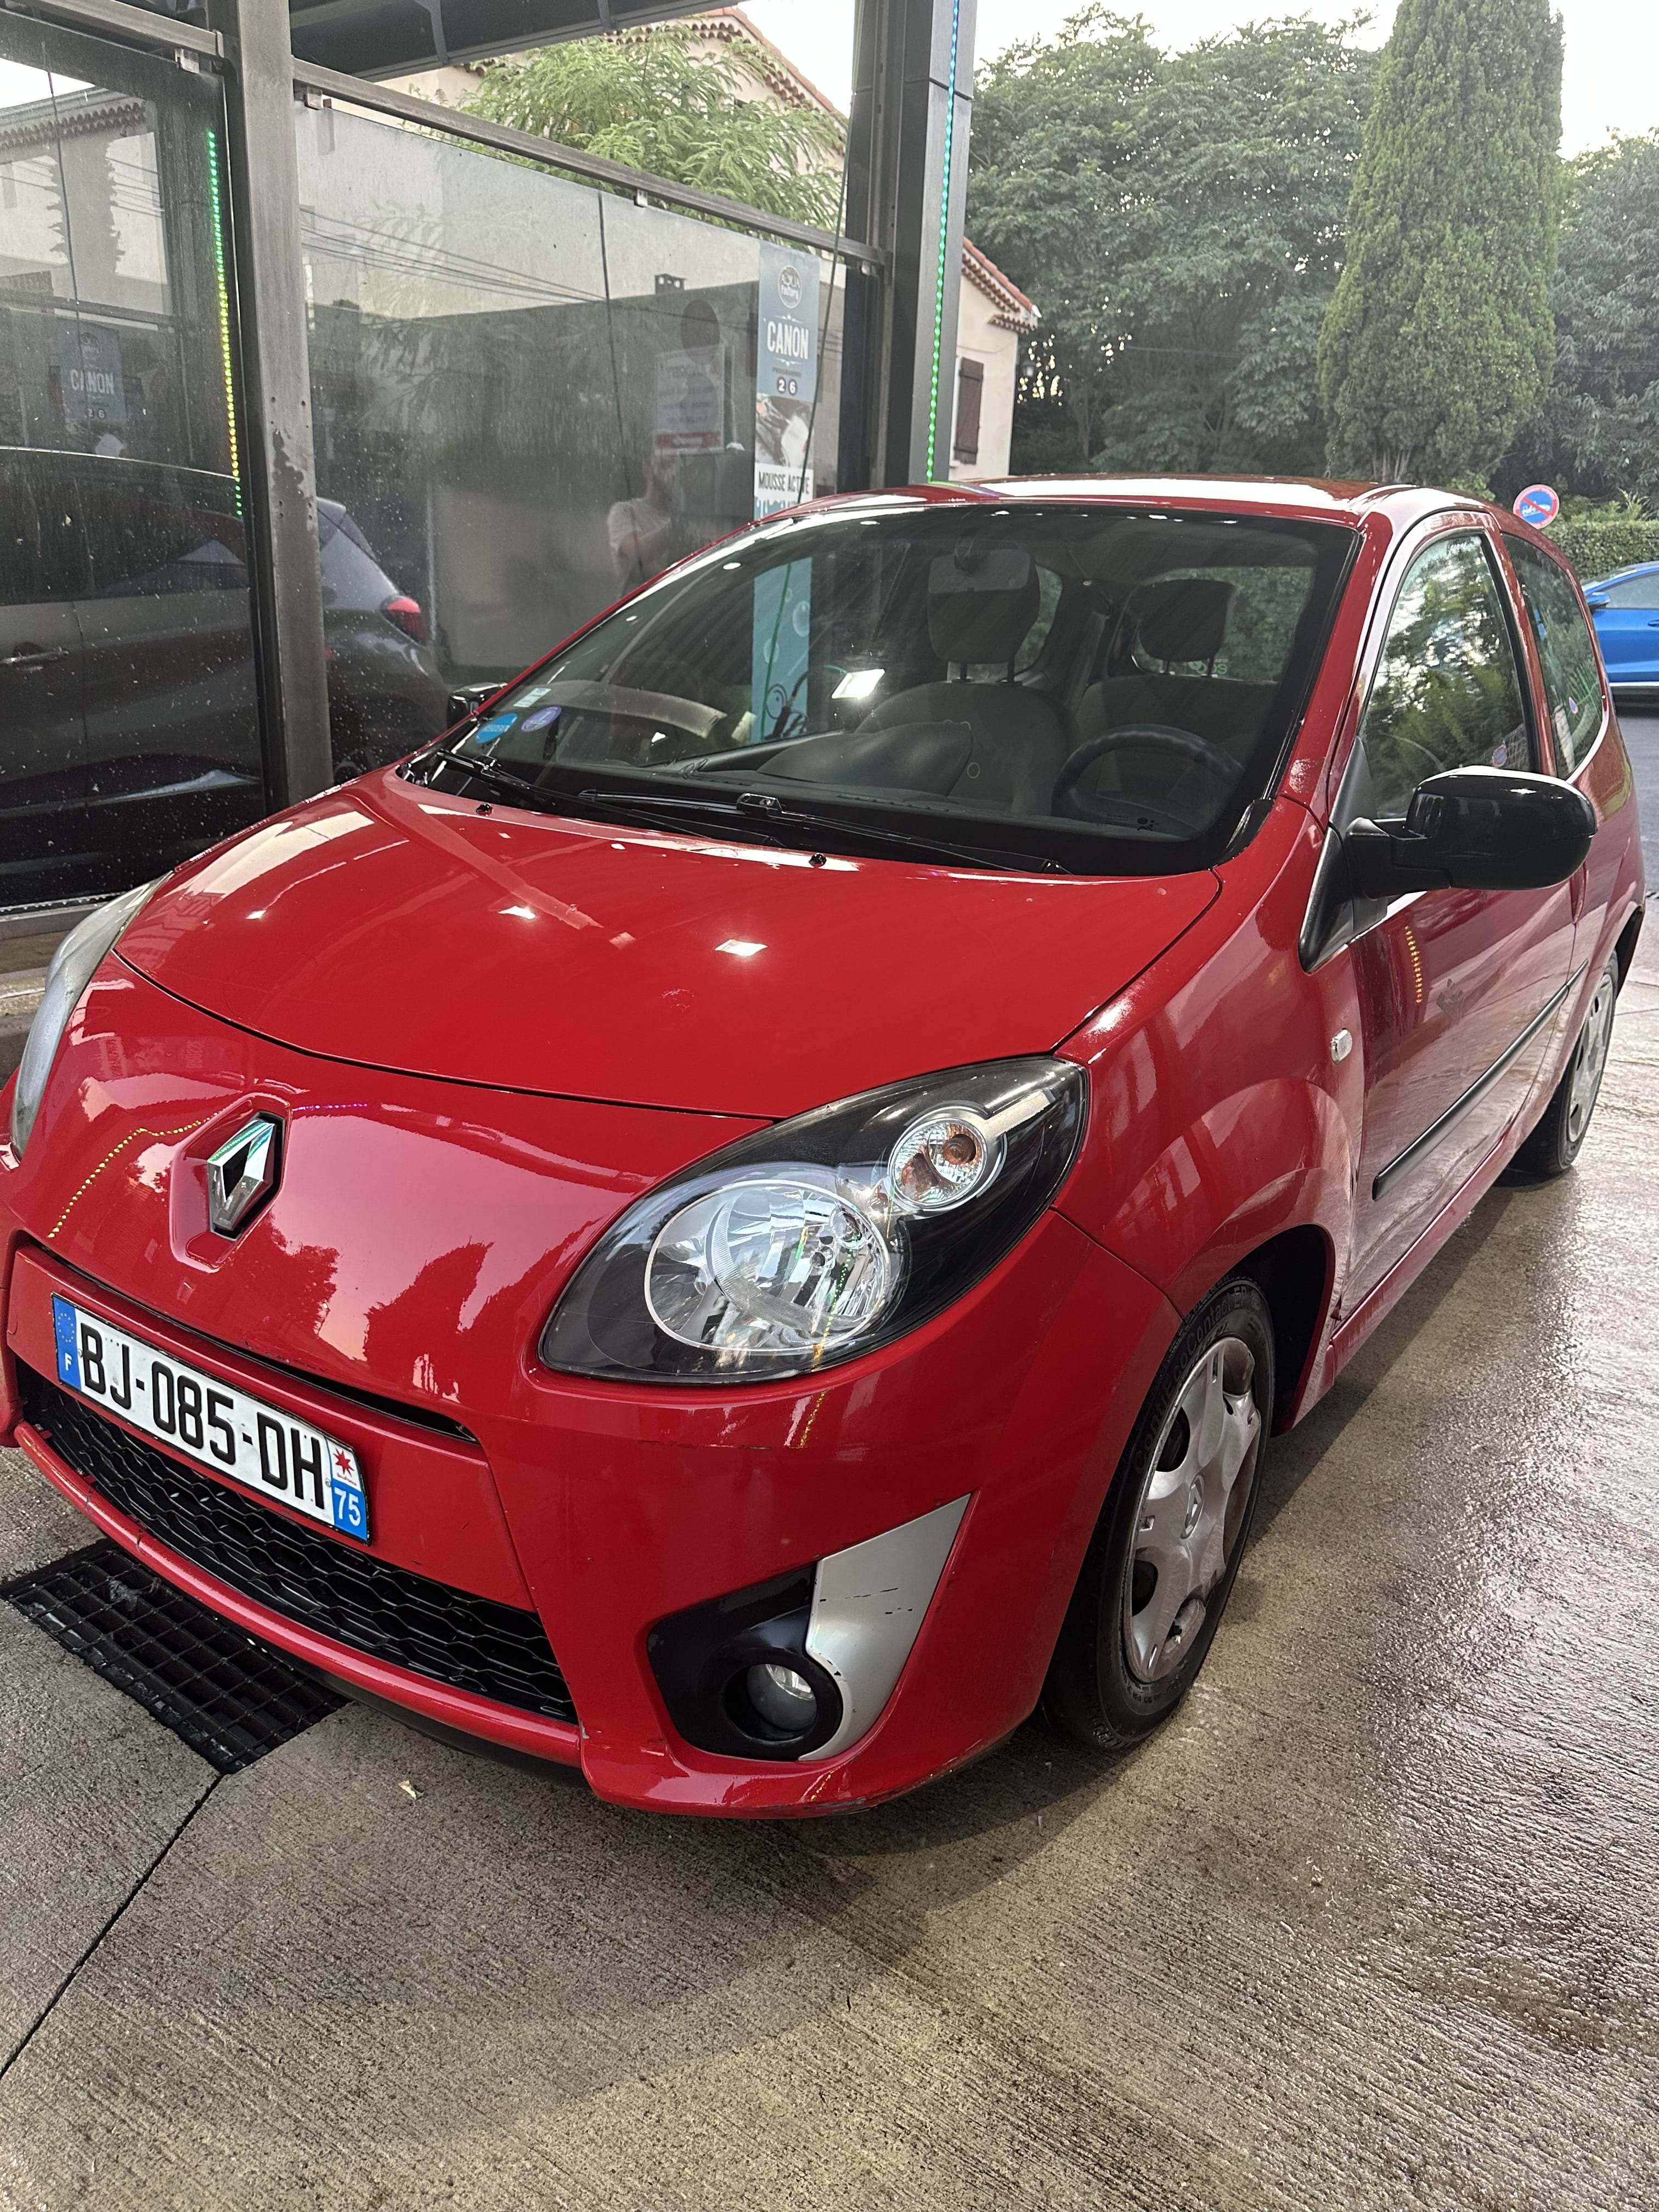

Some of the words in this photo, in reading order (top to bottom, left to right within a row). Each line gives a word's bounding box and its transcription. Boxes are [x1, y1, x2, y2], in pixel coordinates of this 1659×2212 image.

[767, 321, 809, 360] CANON
[778, 379, 785, 392] 2
[789, 381, 796, 394] 6
[98, 409, 105, 419] 6
[758, 471, 786, 492] MOUSSE
[1233, 1285, 1247, 1309] EP
[64, 1352, 72, 1371] F
[81, 1322, 325, 1510] BJ-085-DH
[334, 1487, 361, 1526] 75
